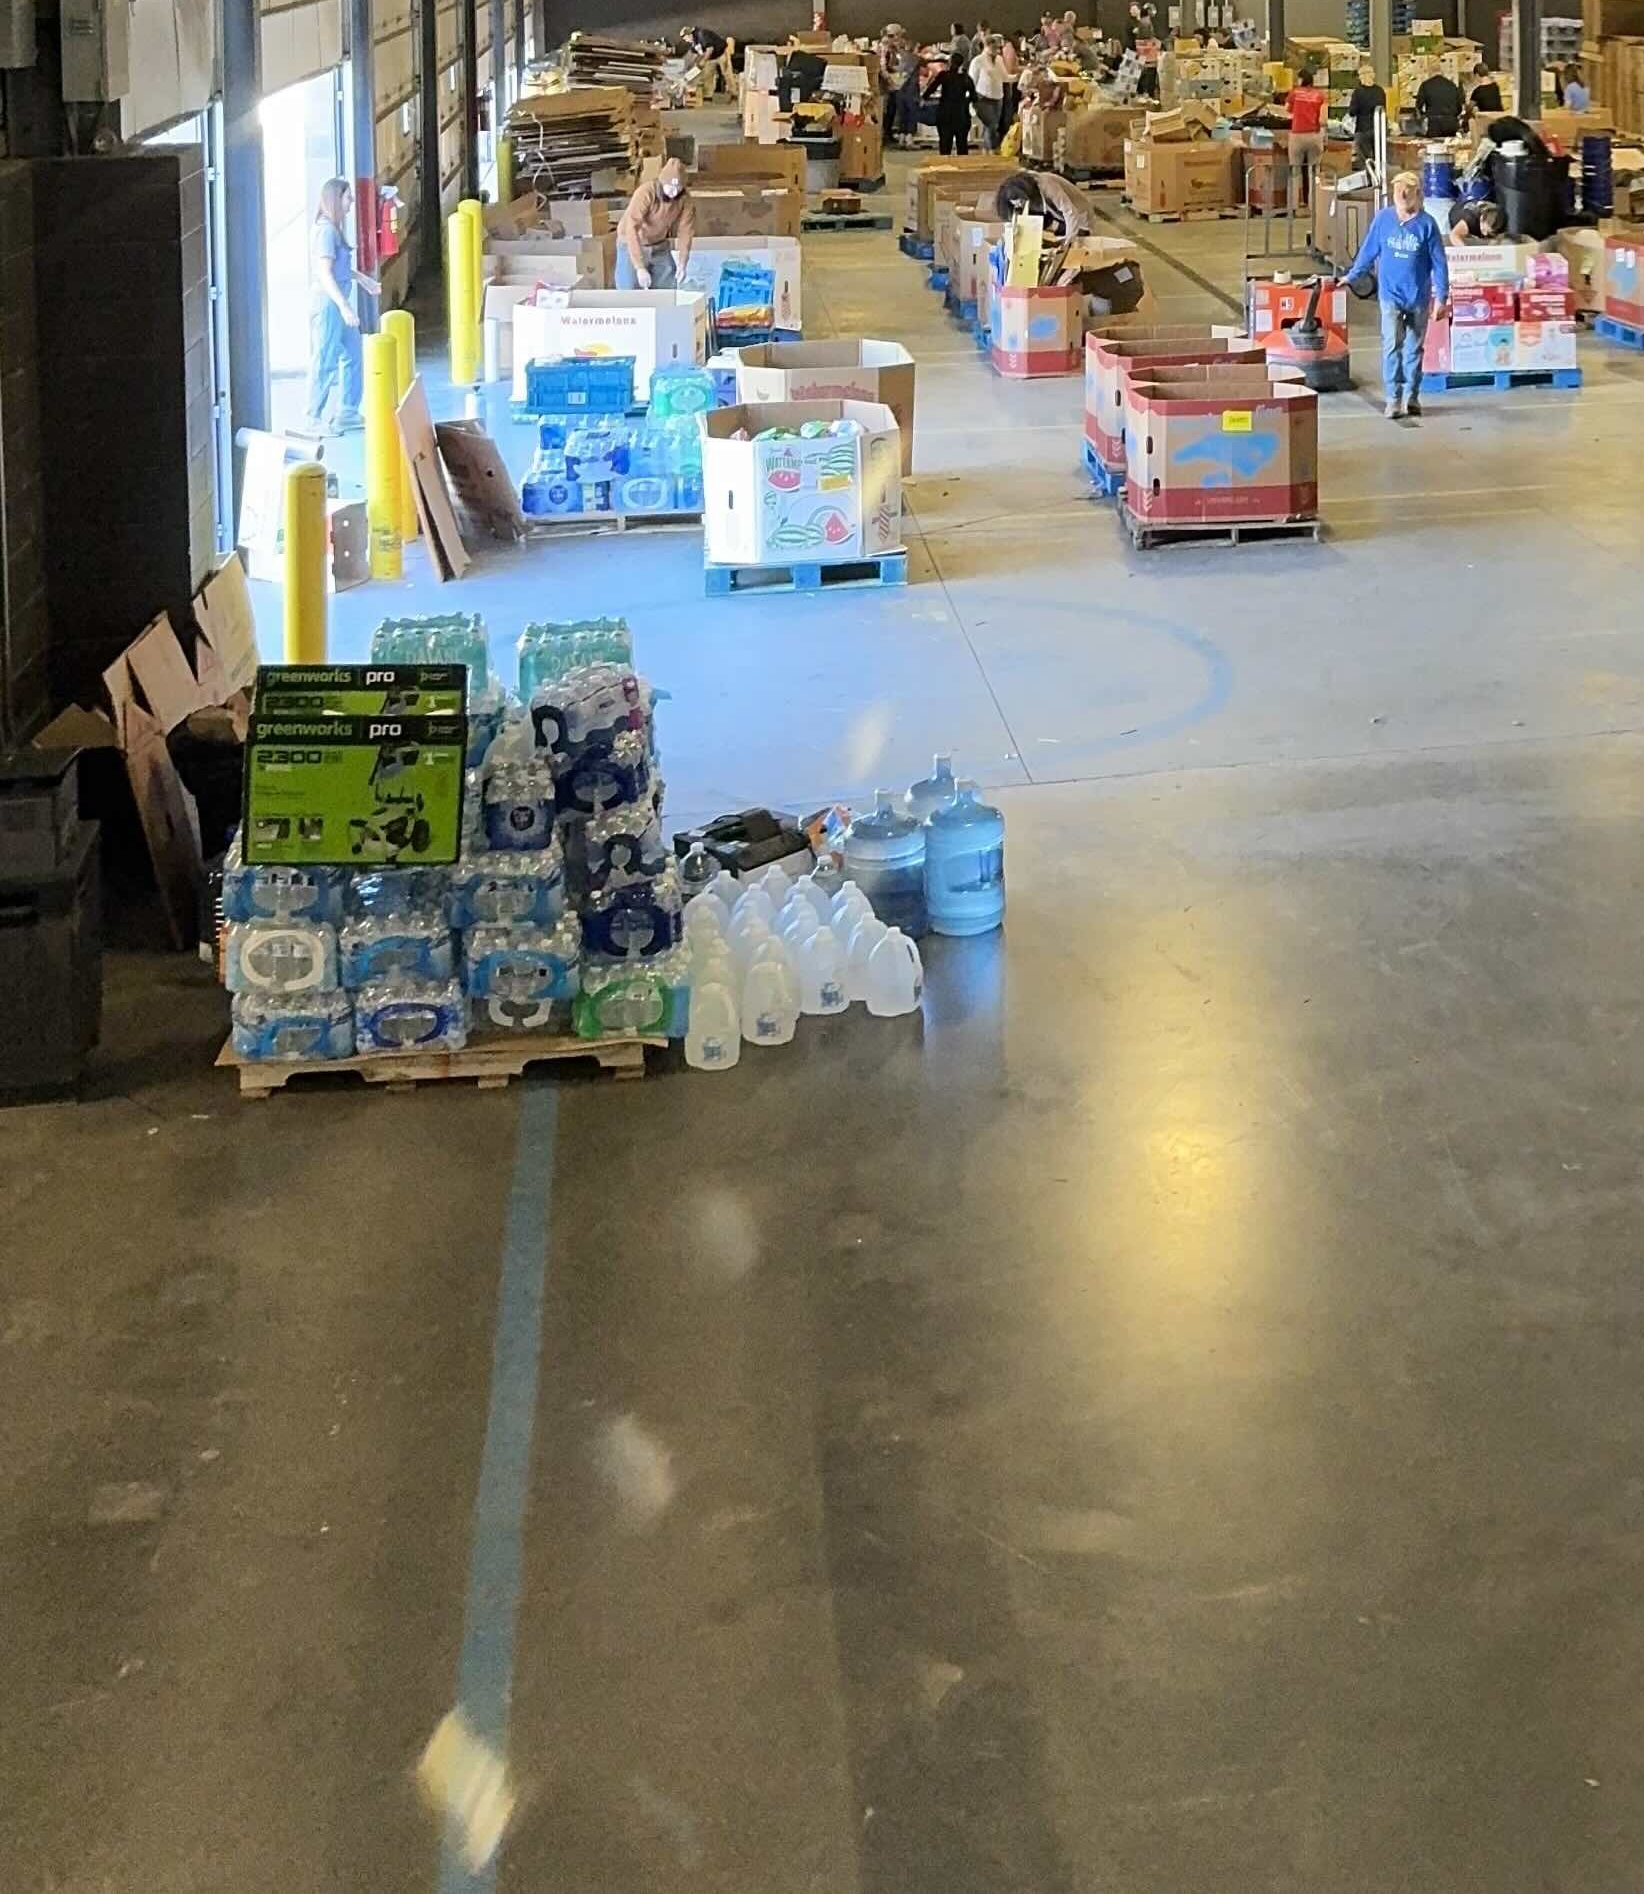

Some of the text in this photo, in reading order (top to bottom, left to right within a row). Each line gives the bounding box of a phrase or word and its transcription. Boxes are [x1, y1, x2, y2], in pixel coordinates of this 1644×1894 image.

[267, 669, 395, 688] greenworks pro
[256, 721, 402, 740] greenworks pro
[256, 750, 323, 765] 2300
